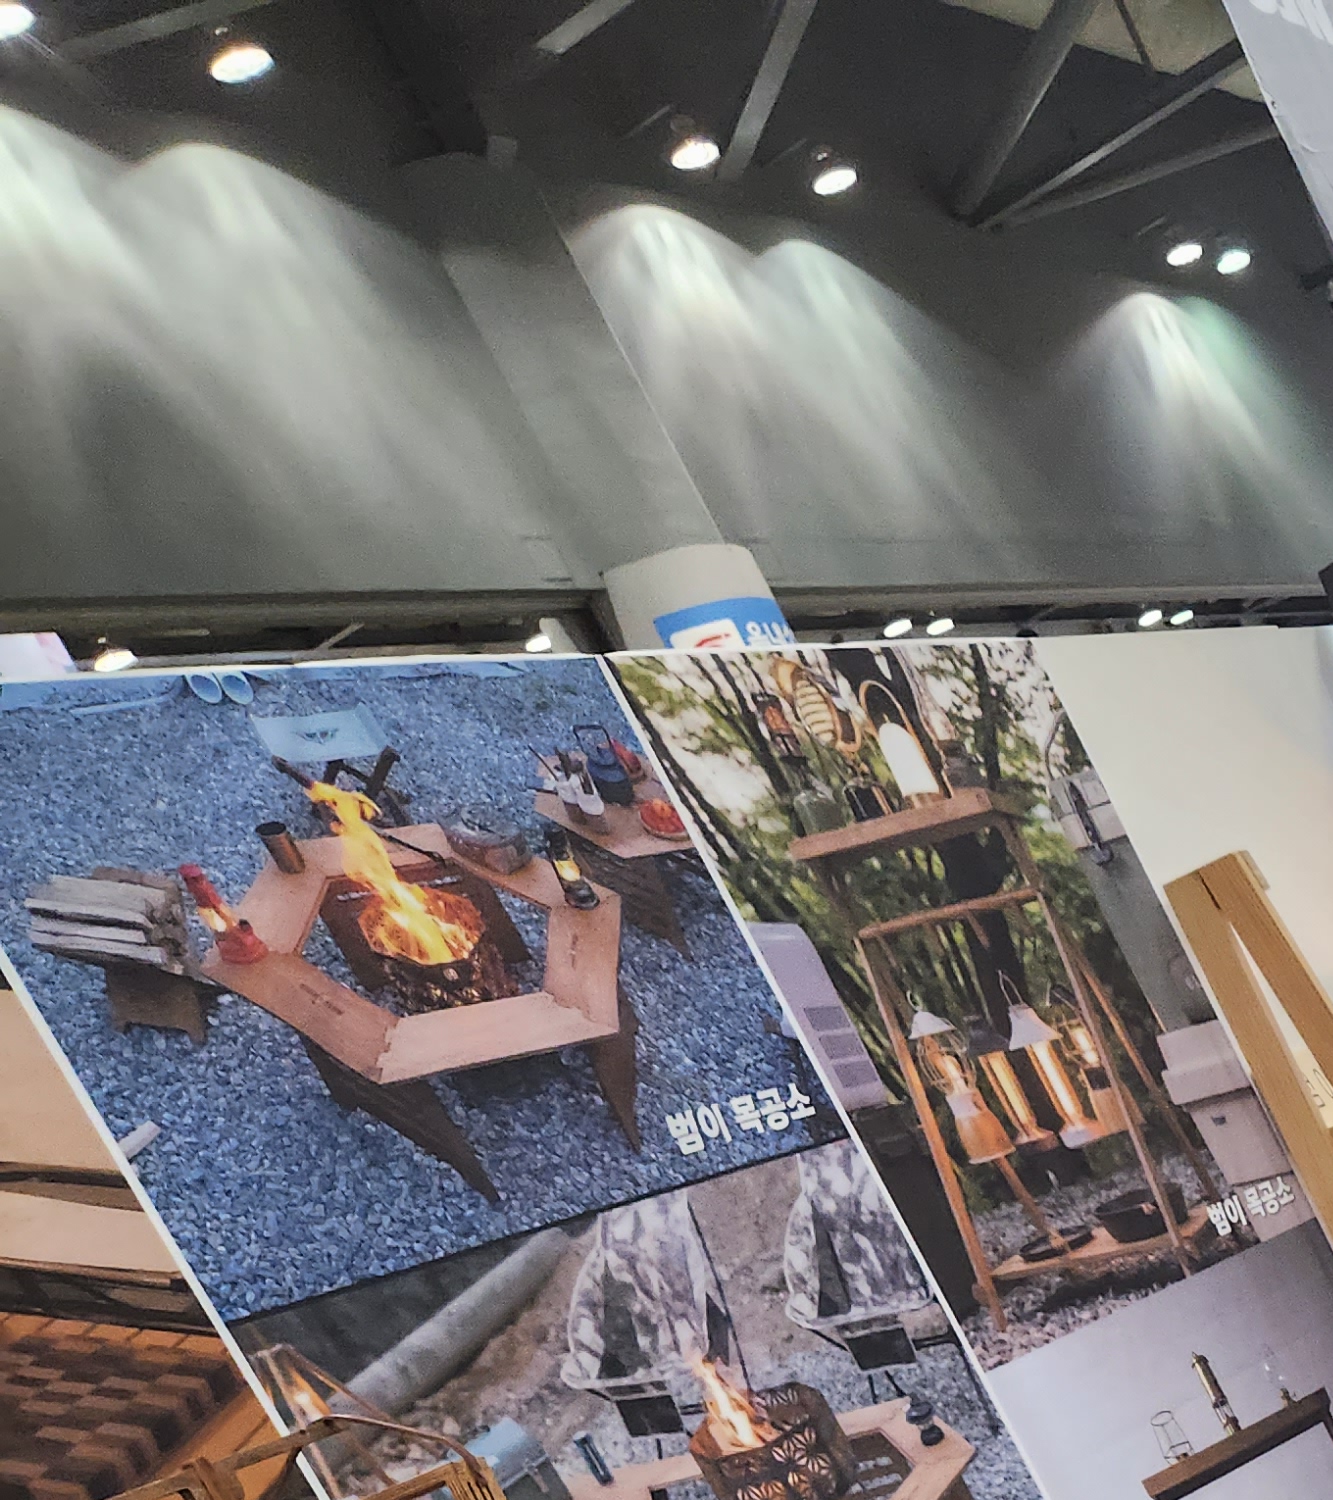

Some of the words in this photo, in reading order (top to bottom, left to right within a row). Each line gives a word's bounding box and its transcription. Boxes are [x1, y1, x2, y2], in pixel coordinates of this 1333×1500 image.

[665, 1103, 732, 1155] 범이
[730, 1083, 816, 1133] 목공소
[1207, 1194, 1248, 1236] 범이
[1244, 1176, 1295, 1217] 목공소
